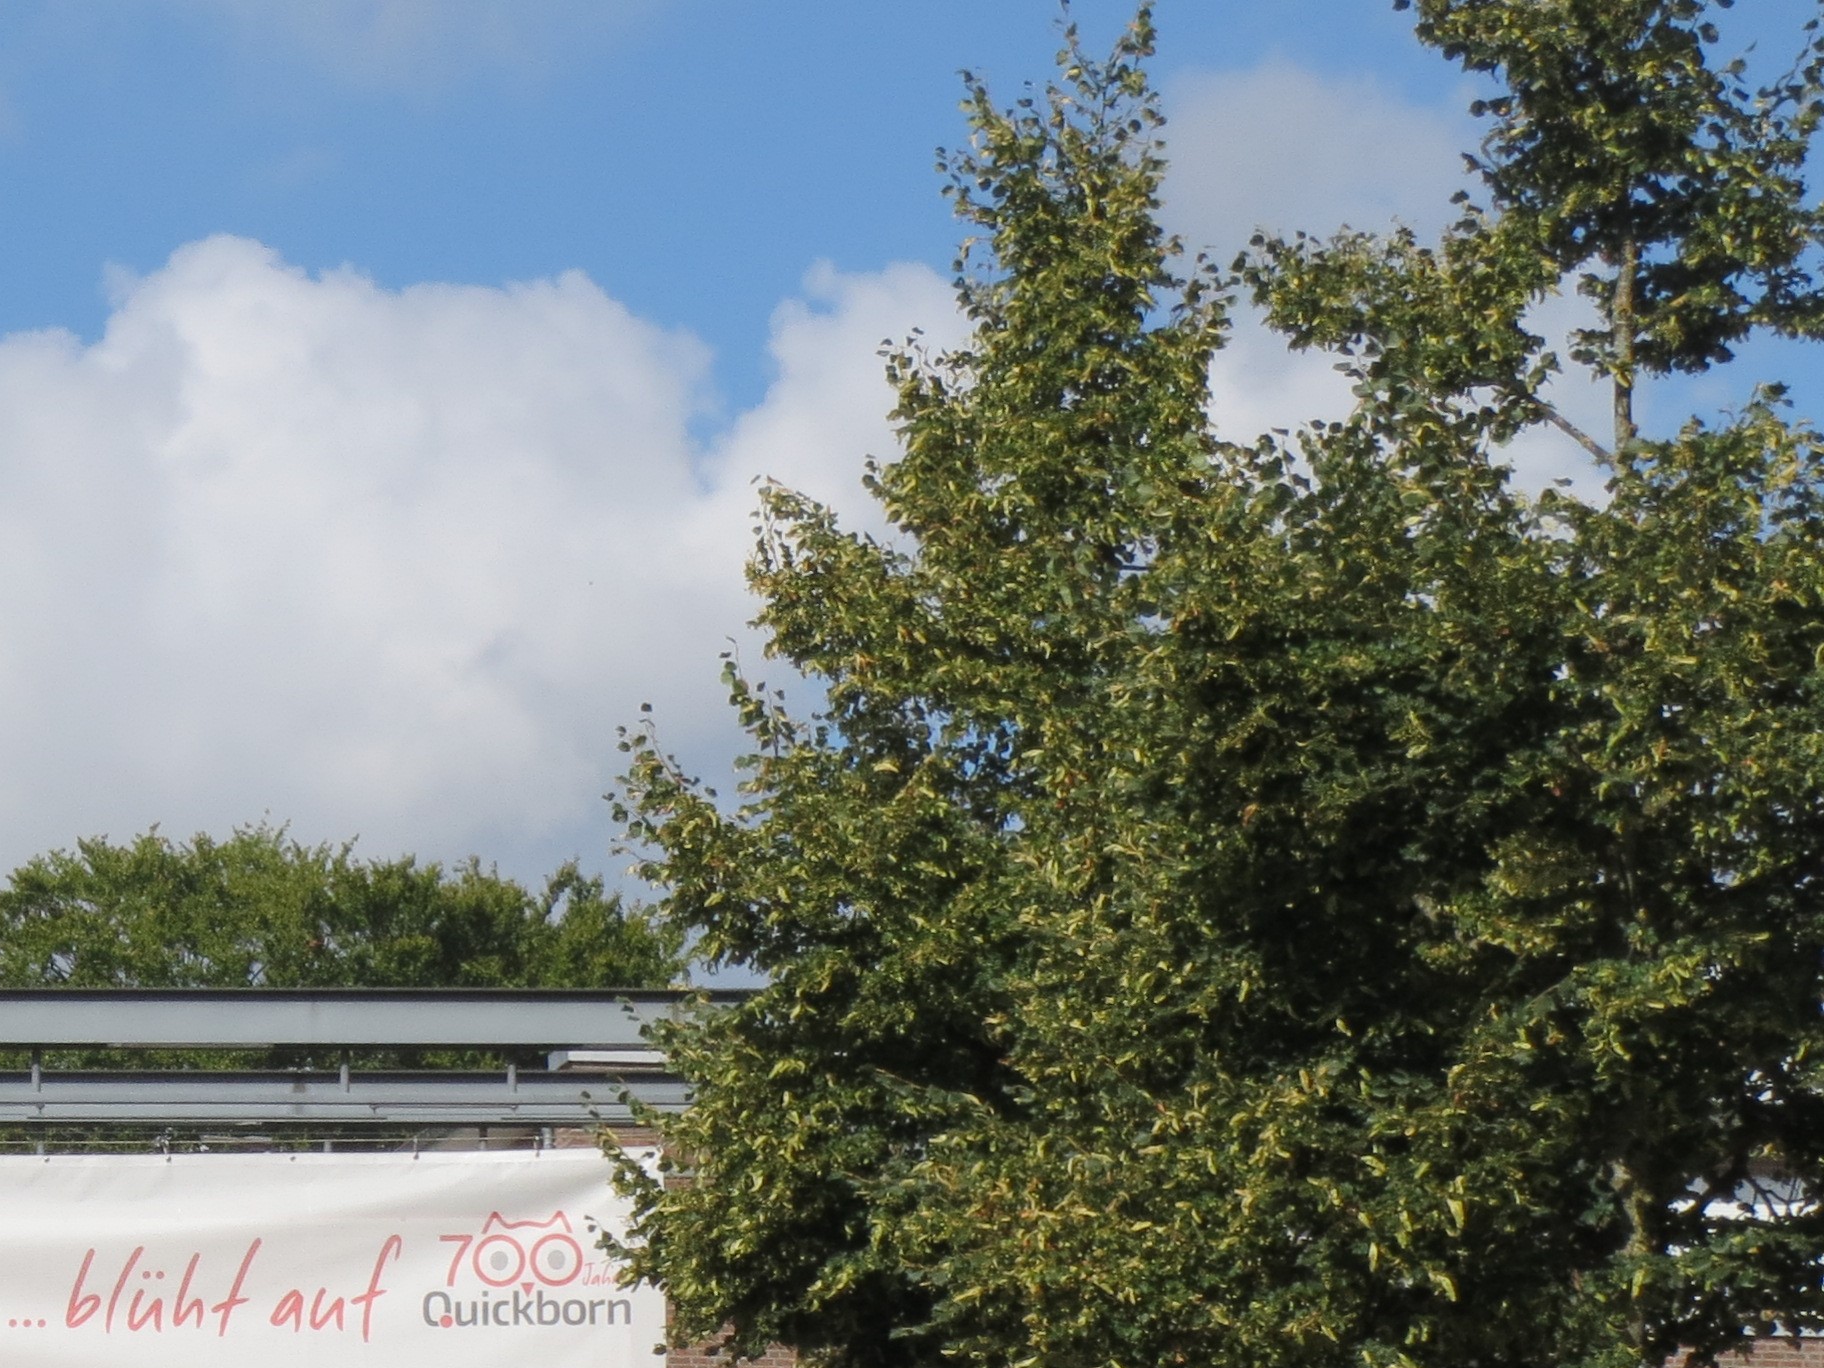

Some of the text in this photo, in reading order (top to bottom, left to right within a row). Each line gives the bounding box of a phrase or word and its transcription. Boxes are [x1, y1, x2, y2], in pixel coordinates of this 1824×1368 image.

[65, 1237, 263, 1337] blüht
[270, 1233, 402, 1343] auf
[439, 1232, 584, 1288] 700
[423, 1289, 631, 1328] Quickborn
